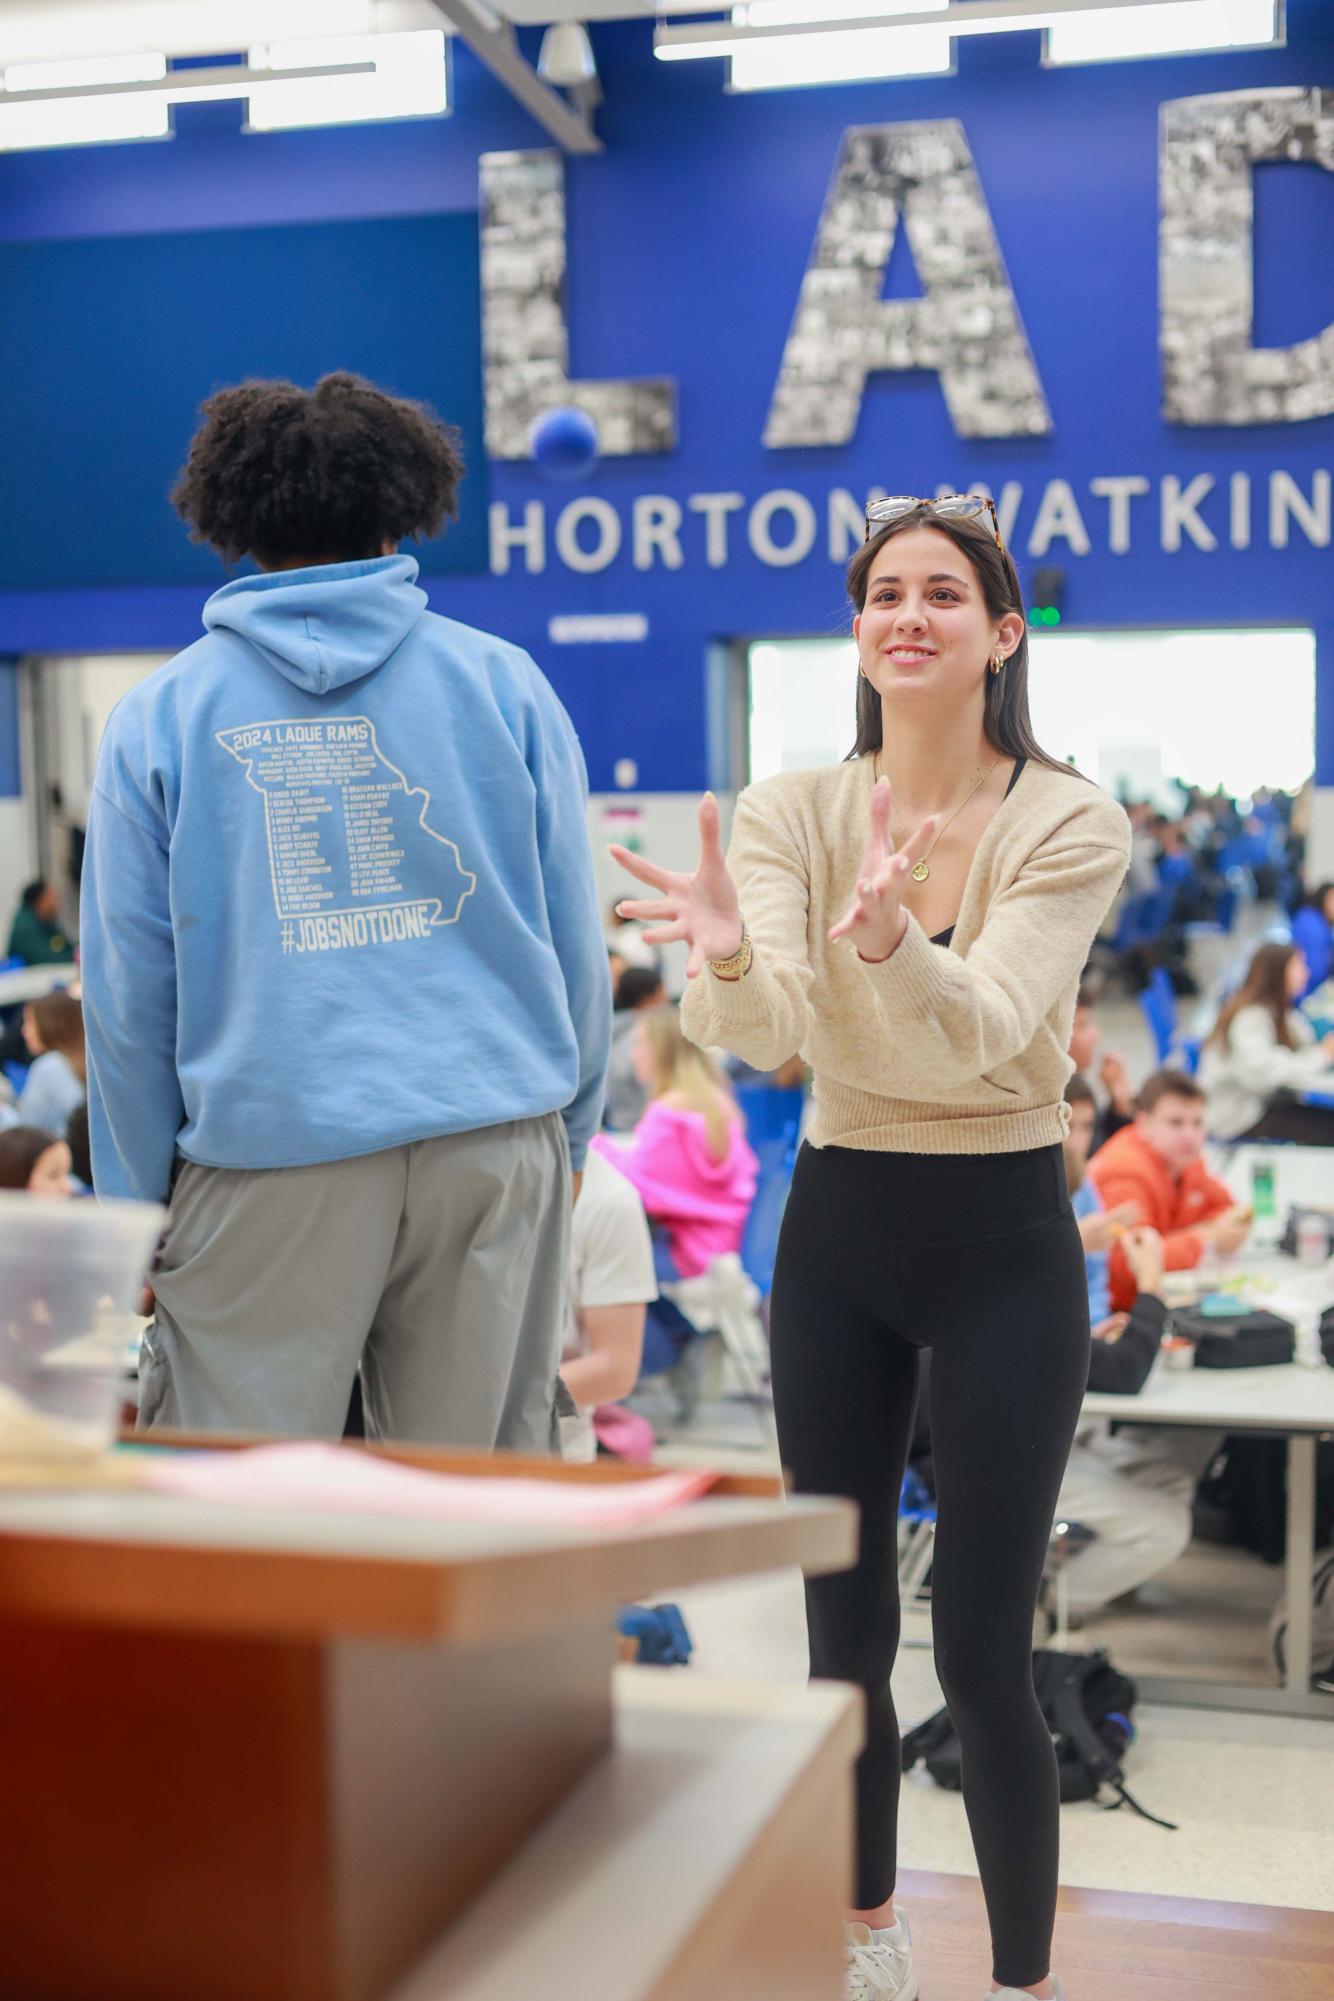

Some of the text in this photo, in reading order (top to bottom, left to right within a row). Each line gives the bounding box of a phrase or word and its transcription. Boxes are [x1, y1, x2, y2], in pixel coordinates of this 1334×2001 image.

[478, 86, 1334, 461] LAD
[233, 729, 272, 750] 2024
[276, 727, 323, 743] LADUE
[327, 724, 369, 741] RAMS
[281, 905, 431, 954] #JOBSNOTDONE
